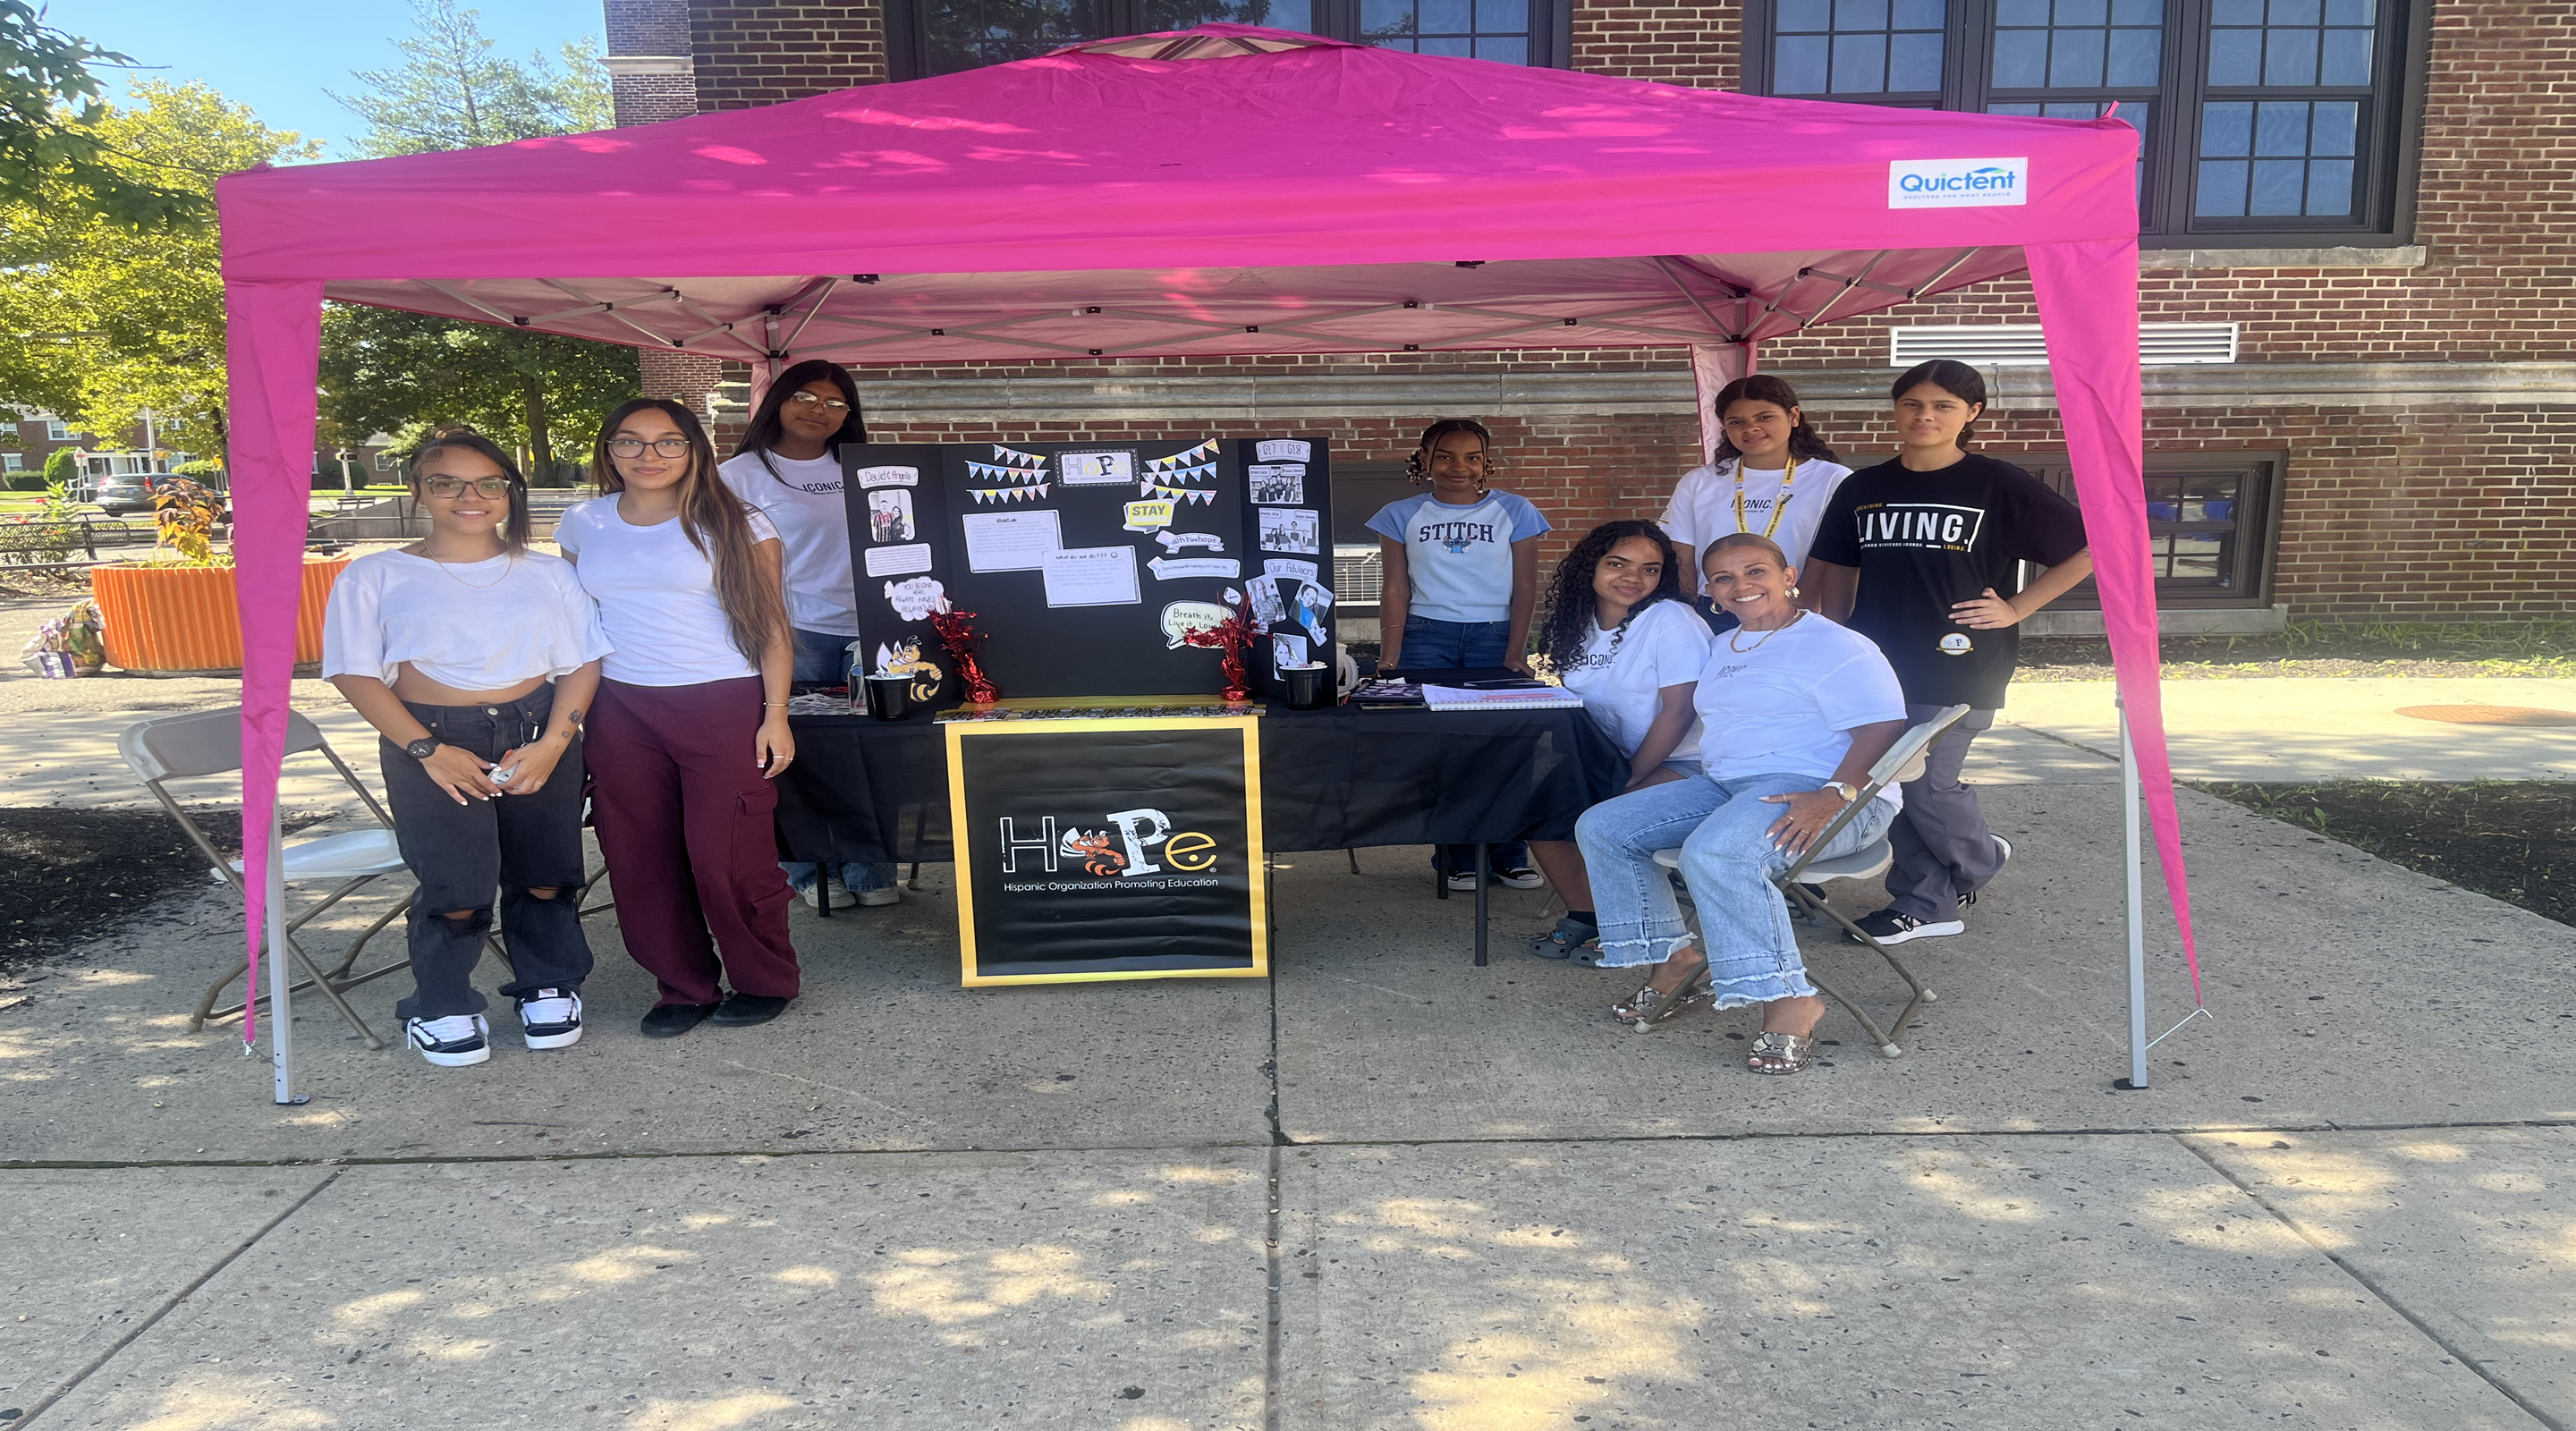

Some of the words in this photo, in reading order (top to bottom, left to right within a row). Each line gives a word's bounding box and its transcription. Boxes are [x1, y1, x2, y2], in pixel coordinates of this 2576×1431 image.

[1900, 171, 2015, 192] Quictent
[865, 471, 886, 482] David
[892, 470, 911, 482] Angela
[1132, 505, 1165, 515] STAY
[1730, 499, 1773, 509] IONIC.
[1419, 521, 1495, 543] STITCH
[1270, 563, 1282, 573] Our
[1286, 562, 1315, 577] Advisors
[1174, 608, 1201, 619] Breath
[1168, 619, 1185, 627] Live
[1004, 882, 1046, 893] Hispanic
[1048, 881, 1112, 892] Organization
[1114, 879, 1165, 891] Promoting
[1167, 877, 1218, 888] Education
